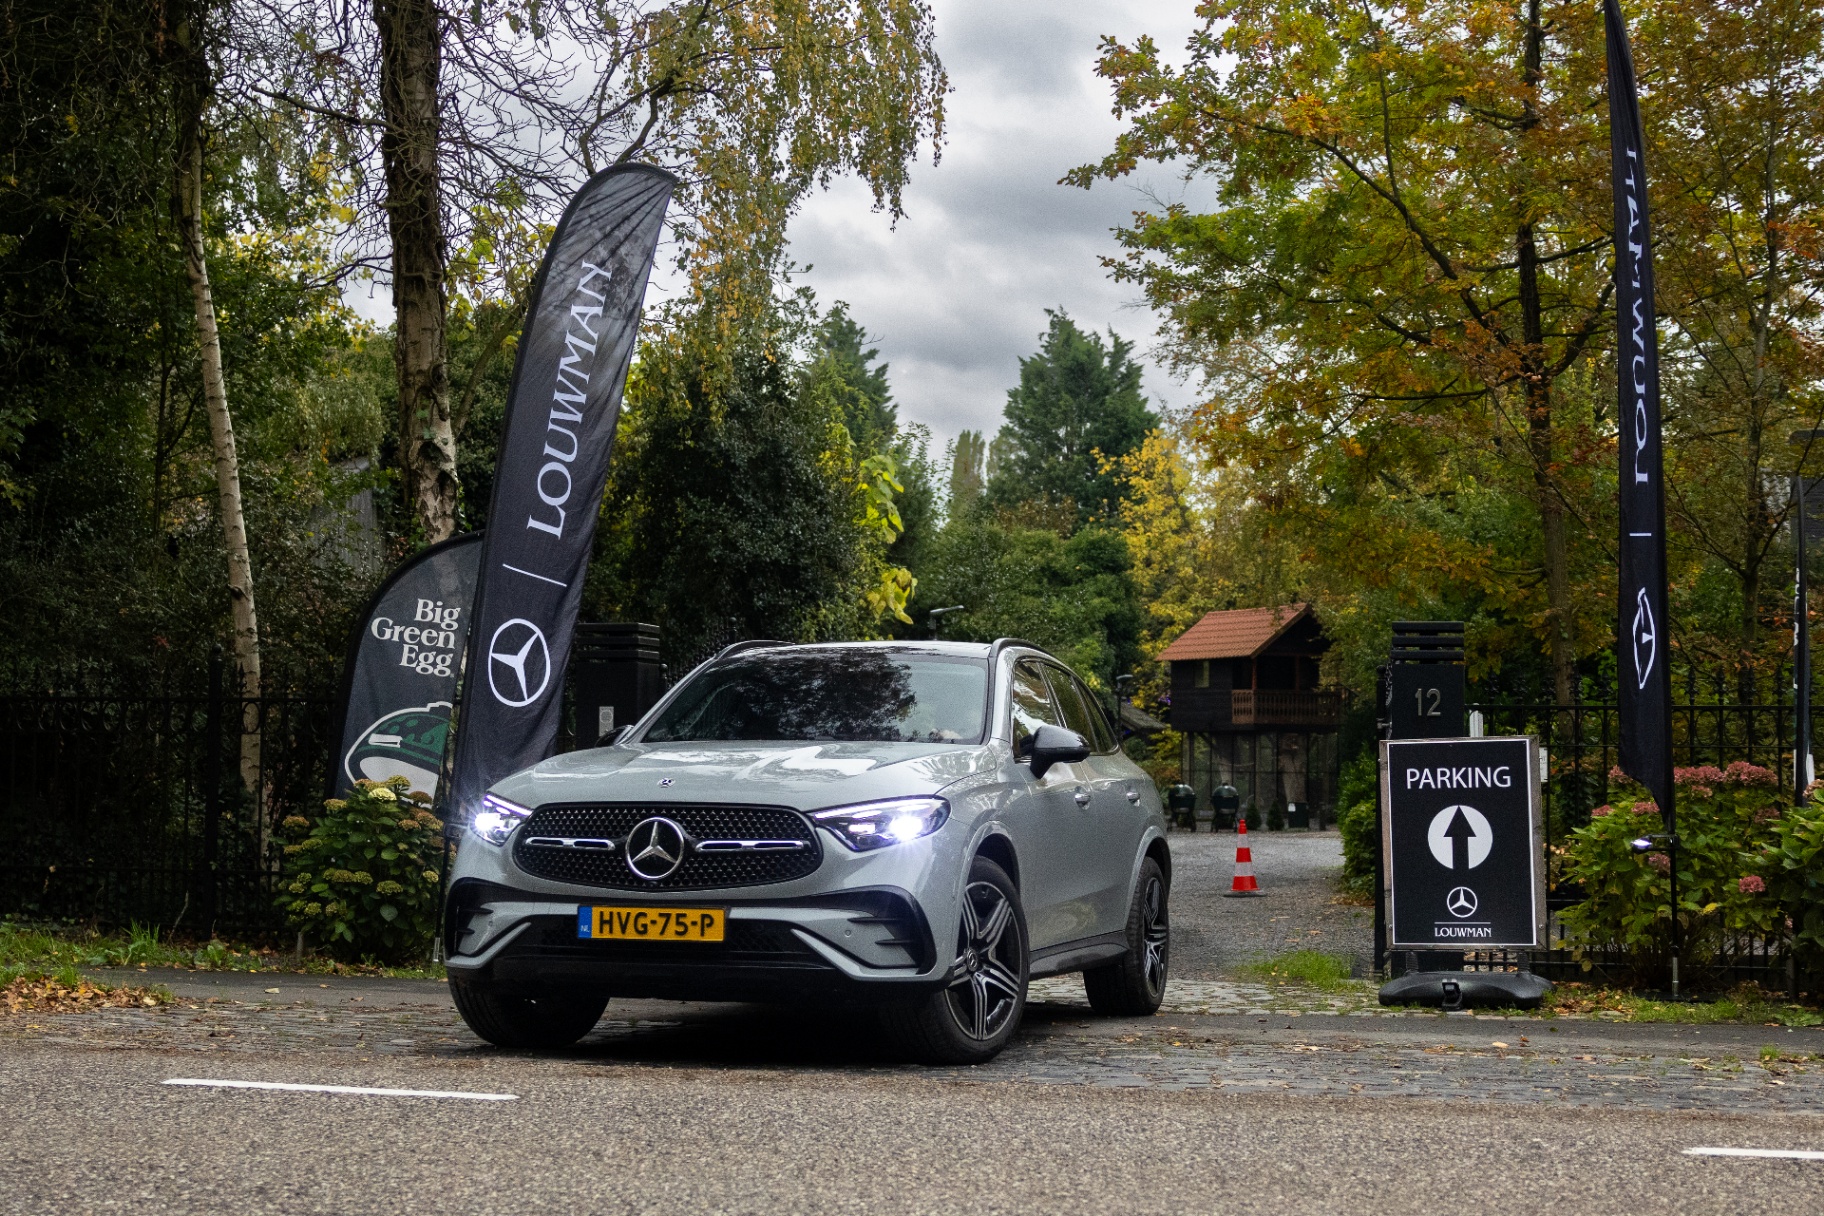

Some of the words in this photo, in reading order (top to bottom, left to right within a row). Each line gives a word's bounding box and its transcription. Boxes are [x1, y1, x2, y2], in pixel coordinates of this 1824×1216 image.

[526, 260, 612, 540] LOUWMAN
[414, 598, 461, 631] Big
[371, 617, 456, 649] Green
[399, 643, 454, 677] Egg
[1415, 688, 1441, 717] 12
[1406, 765, 1512, 790] PARKING
[580, 924, 590, 933] NL
[599, 910, 715, 937] HVG-75-P
[1434, 926, 1492, 938] LOUWMAN
